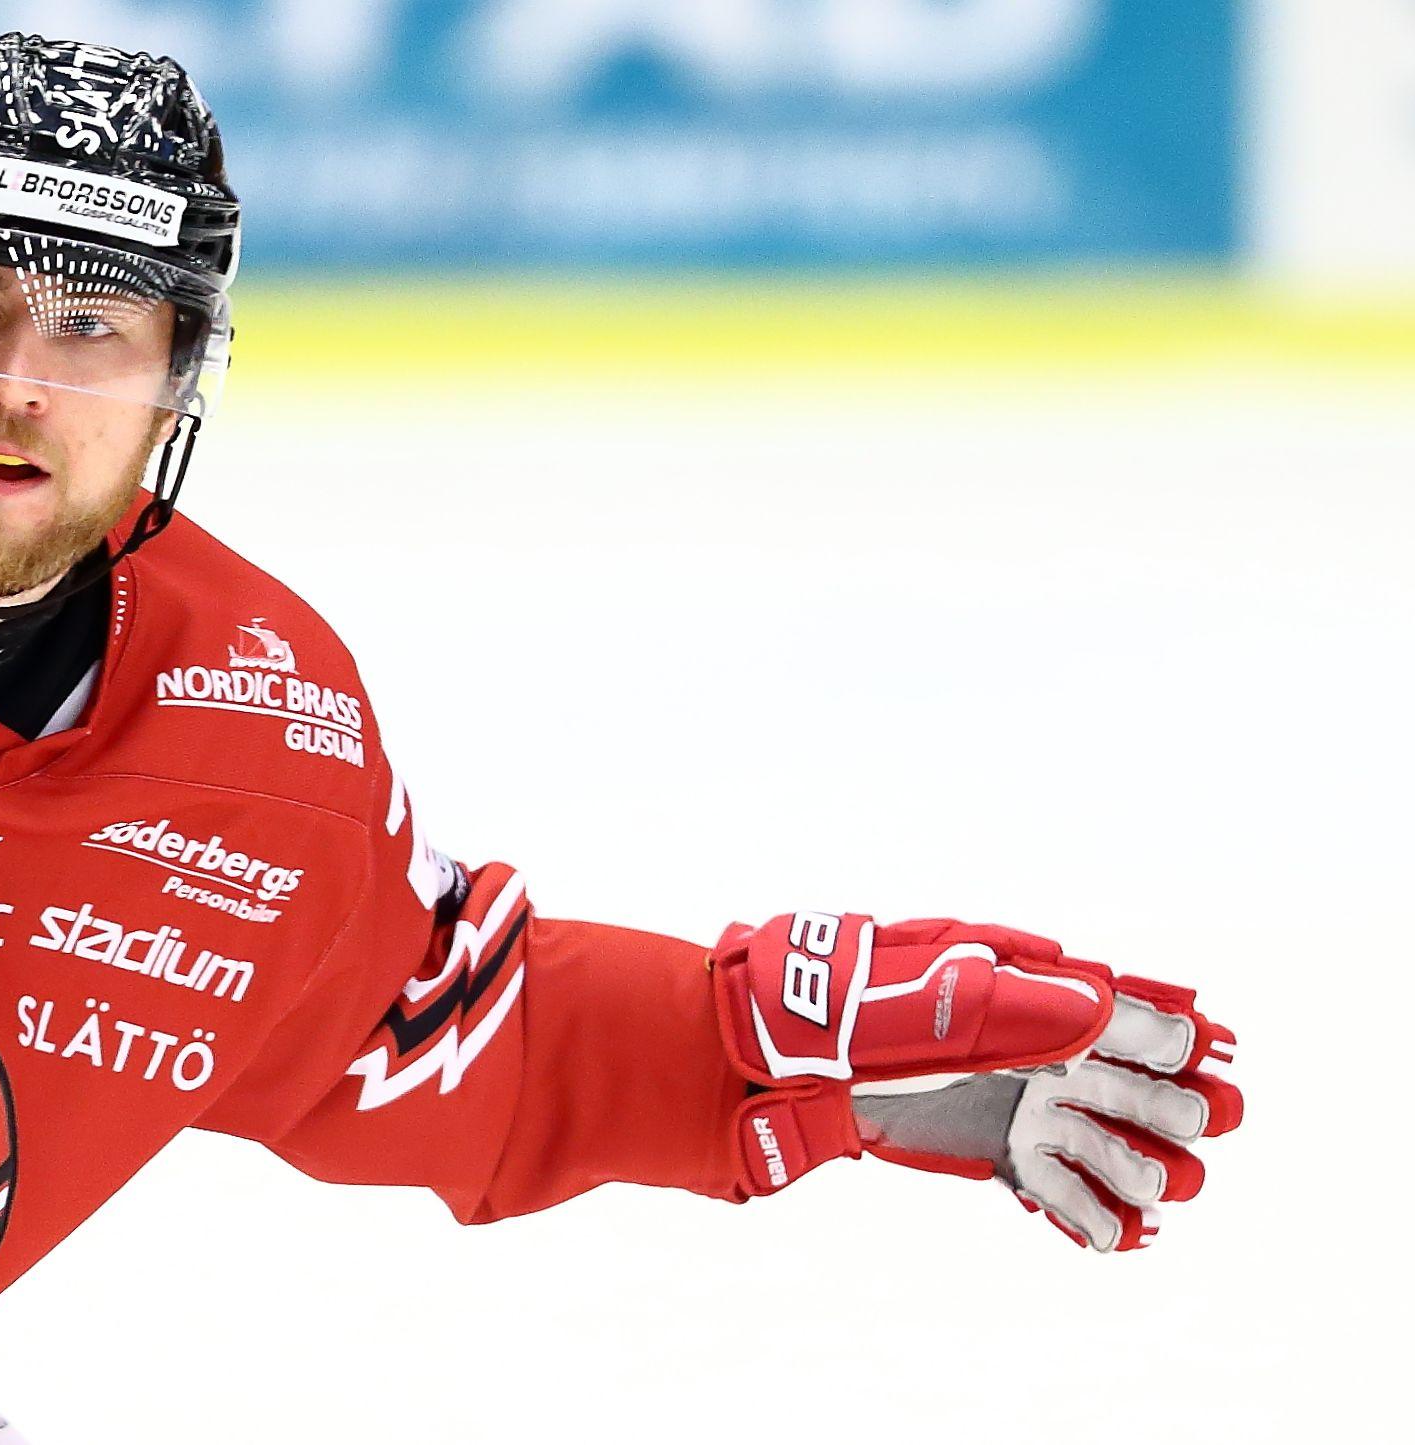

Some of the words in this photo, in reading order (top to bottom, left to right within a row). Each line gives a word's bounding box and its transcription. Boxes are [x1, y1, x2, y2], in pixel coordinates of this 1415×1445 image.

[21, 172, 176, 224] BRORSSONS
[157, 665, 283, 708] NORDIC
[286, 680, 362, 732] BRASS
[285, 722, 365, 768] GUSUM
[28, 903, 255, 1003] stadium
[16, 994, 216, 1092] SLÄTTÖ
